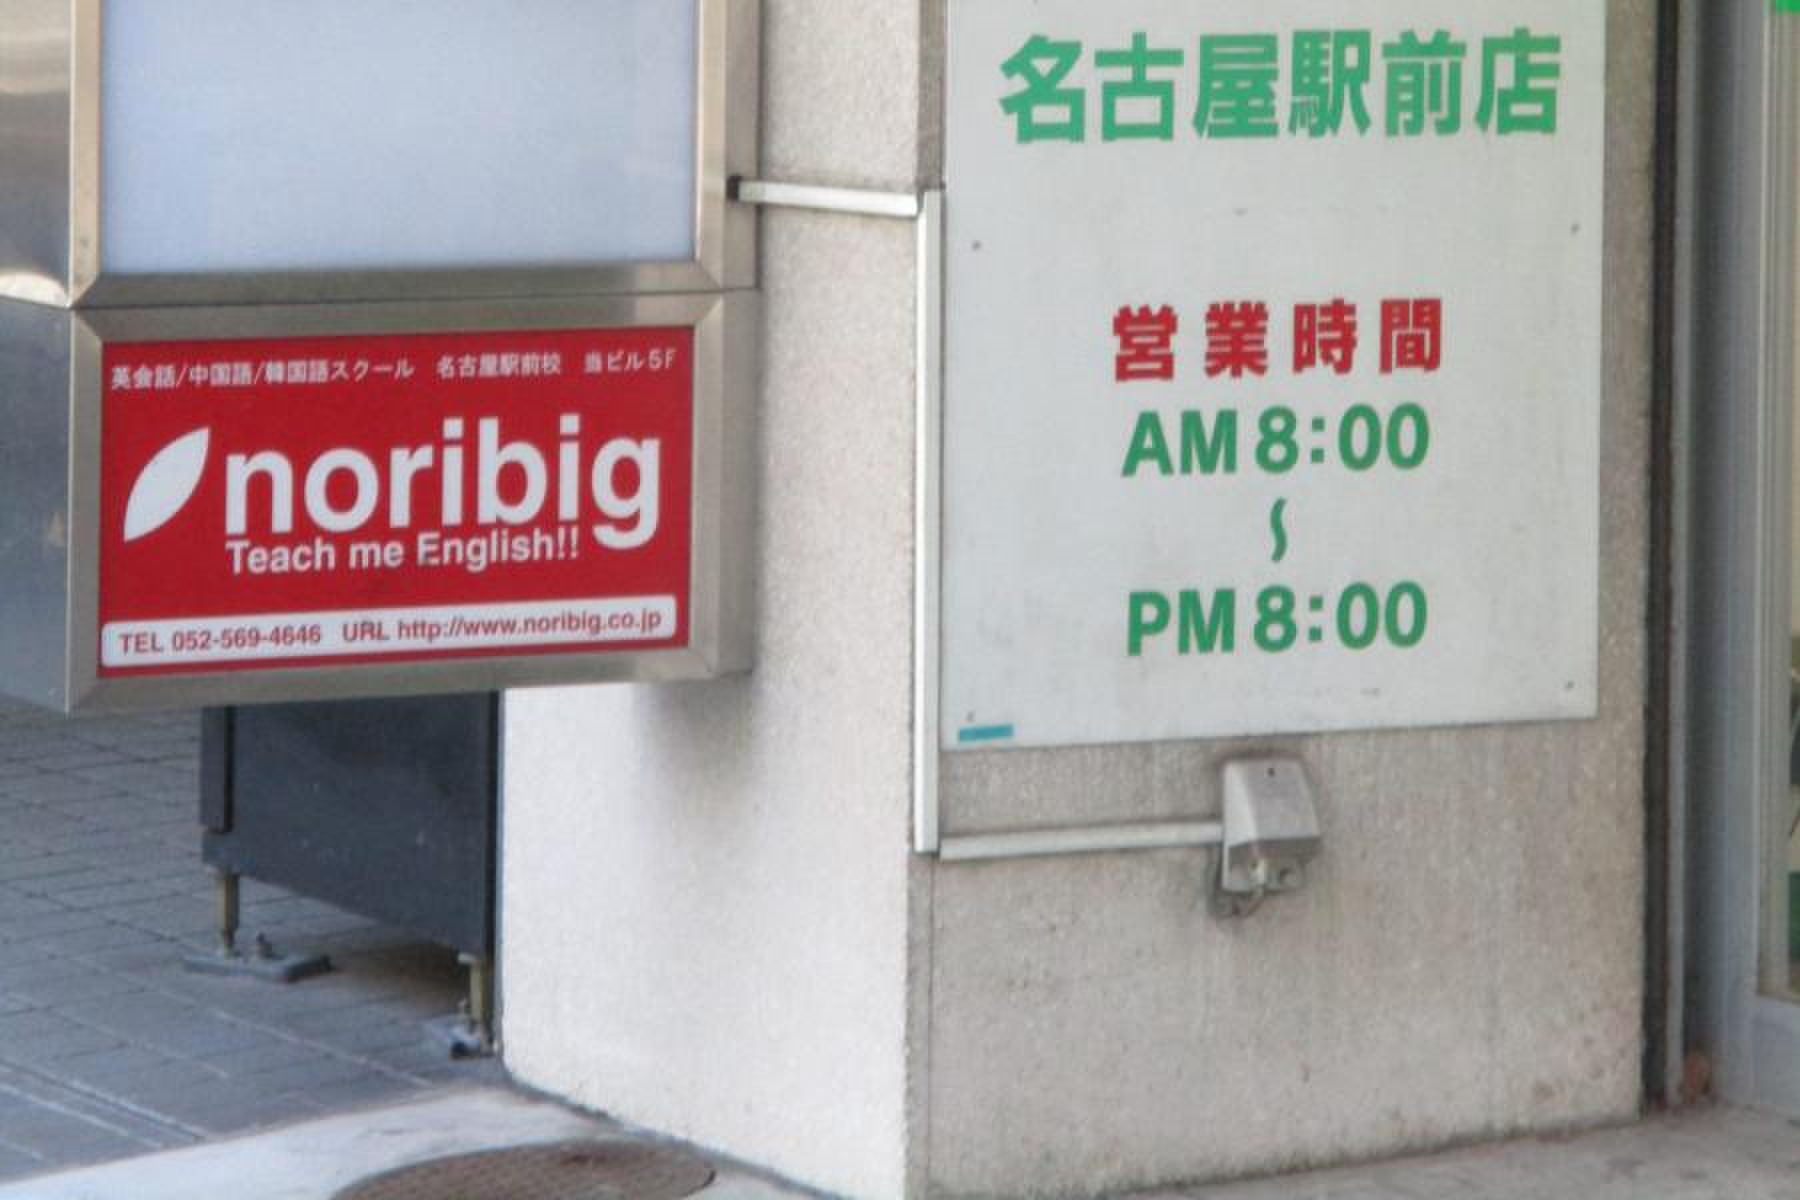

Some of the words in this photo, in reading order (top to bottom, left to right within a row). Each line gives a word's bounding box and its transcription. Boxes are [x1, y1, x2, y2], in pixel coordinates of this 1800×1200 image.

[998, 27, 1562, 144] 名古屋駅前店
[1112, 297, 1442, 382] 営業時間
[225, 412, 661, 550] noribig
[226, 537, 335, 576] Teach
[348, 543, 401, 569] me
[416, 527, 580, 573] English!!
[117, 631, 164, 656] TEL
[170, 621, 322, 652] 052-569-4646
[341, 619, 390, 643] URL
[398, 608, 663, 643] http://www.noribig.co.jp
